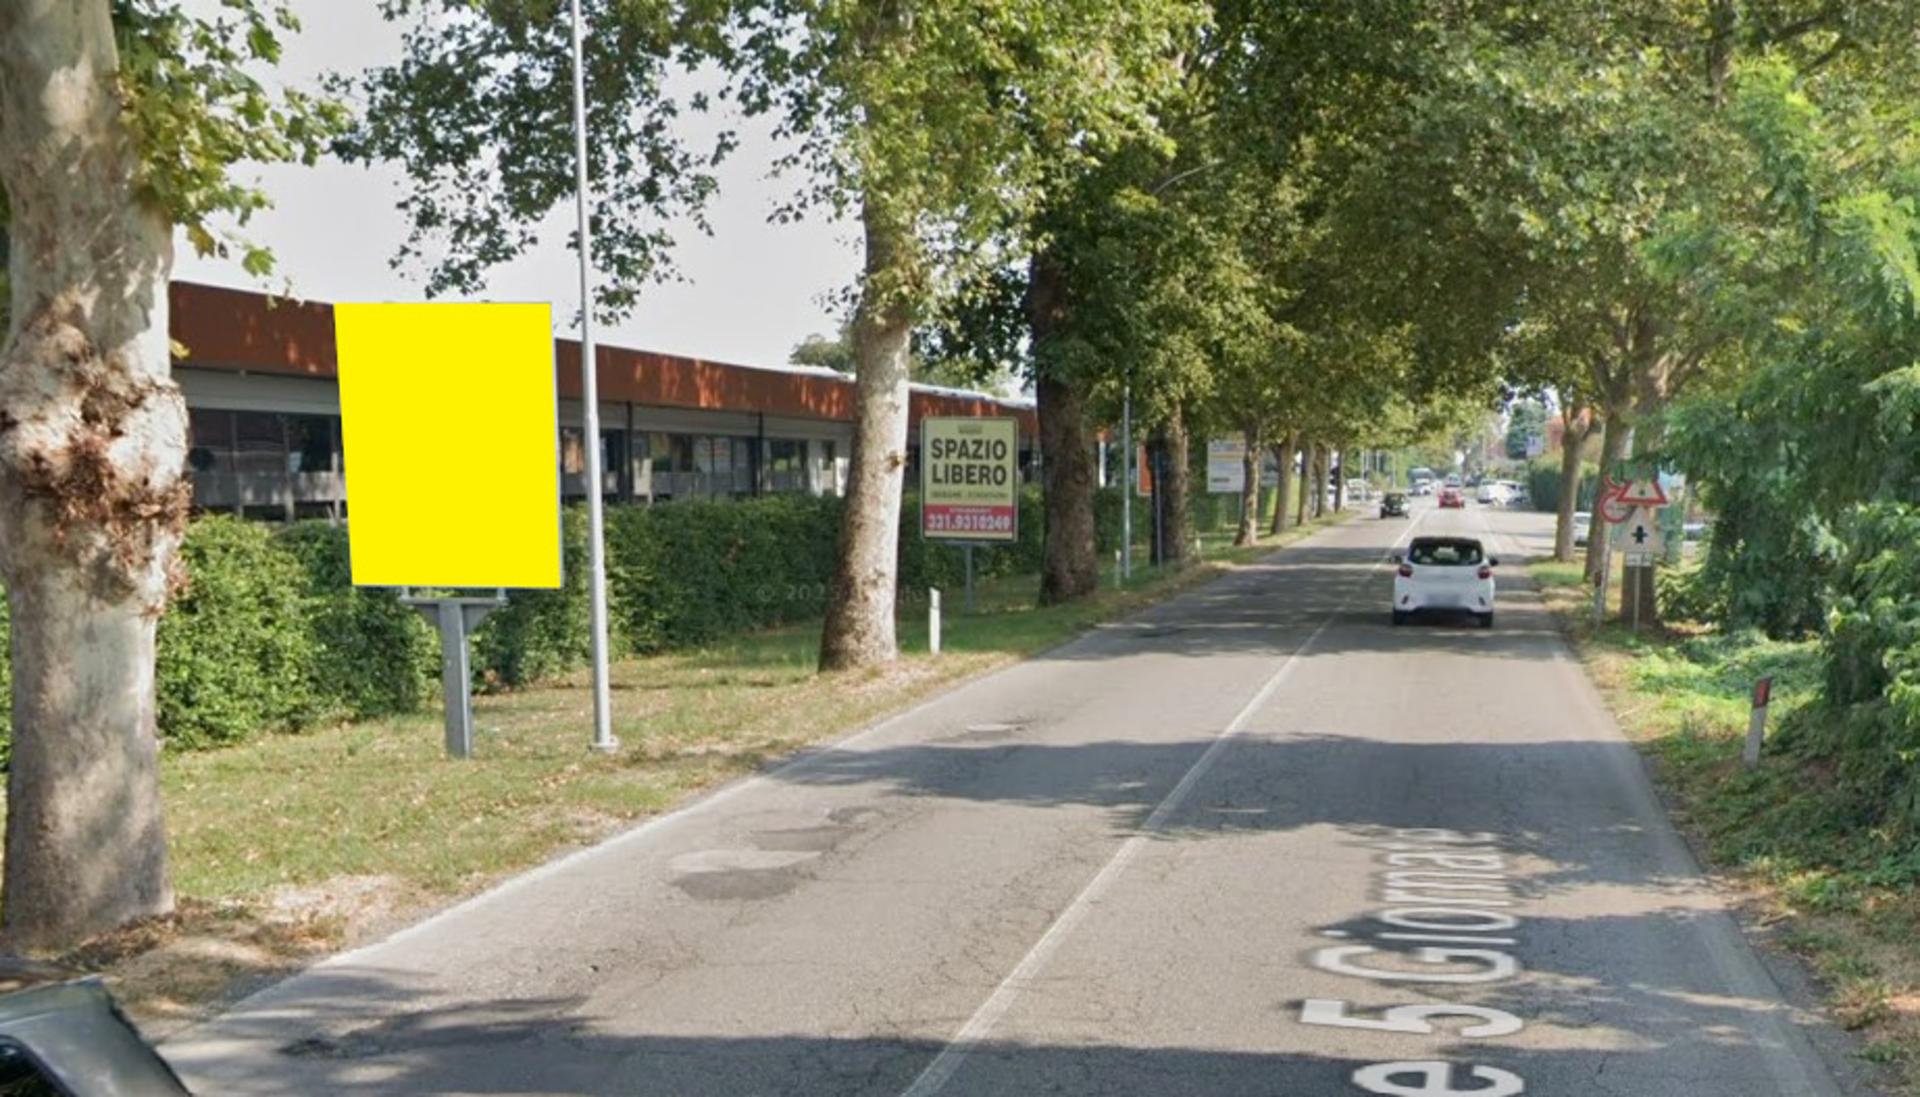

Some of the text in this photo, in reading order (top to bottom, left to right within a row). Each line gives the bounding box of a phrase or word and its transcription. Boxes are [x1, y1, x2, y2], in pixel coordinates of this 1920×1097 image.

[931, 438, 1007, 460] SPAZIO
[932, 464, 1007, 486] LIBERO
[1300, 999, 1524, 1037] 5
